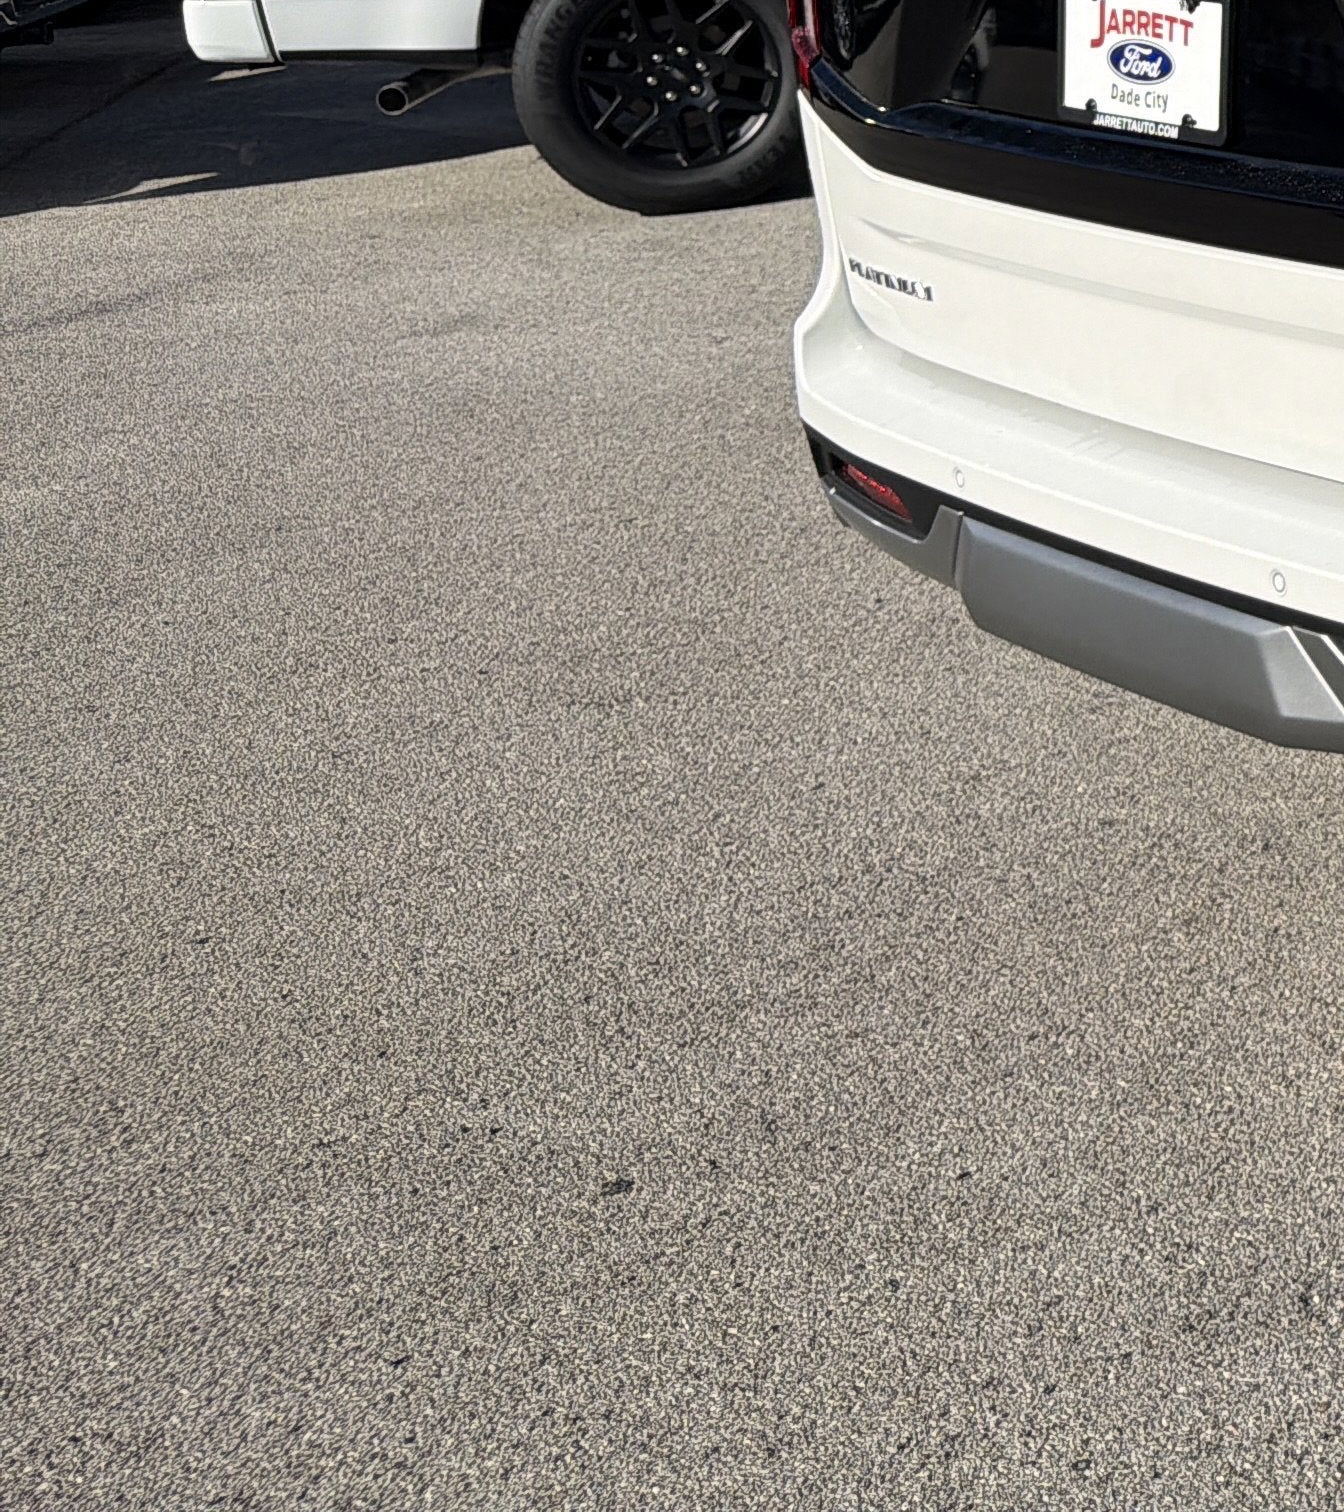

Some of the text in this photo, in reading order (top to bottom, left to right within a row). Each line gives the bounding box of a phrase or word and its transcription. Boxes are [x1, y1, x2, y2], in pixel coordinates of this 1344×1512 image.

[1090, 0, 1194, 48] JARRETT
[1119, 45, 1162, 78] Ford
[1111, 83, 1169, 113] Dade City
[1093, 113, 1179, 139] JARRETTAUTO.COM
